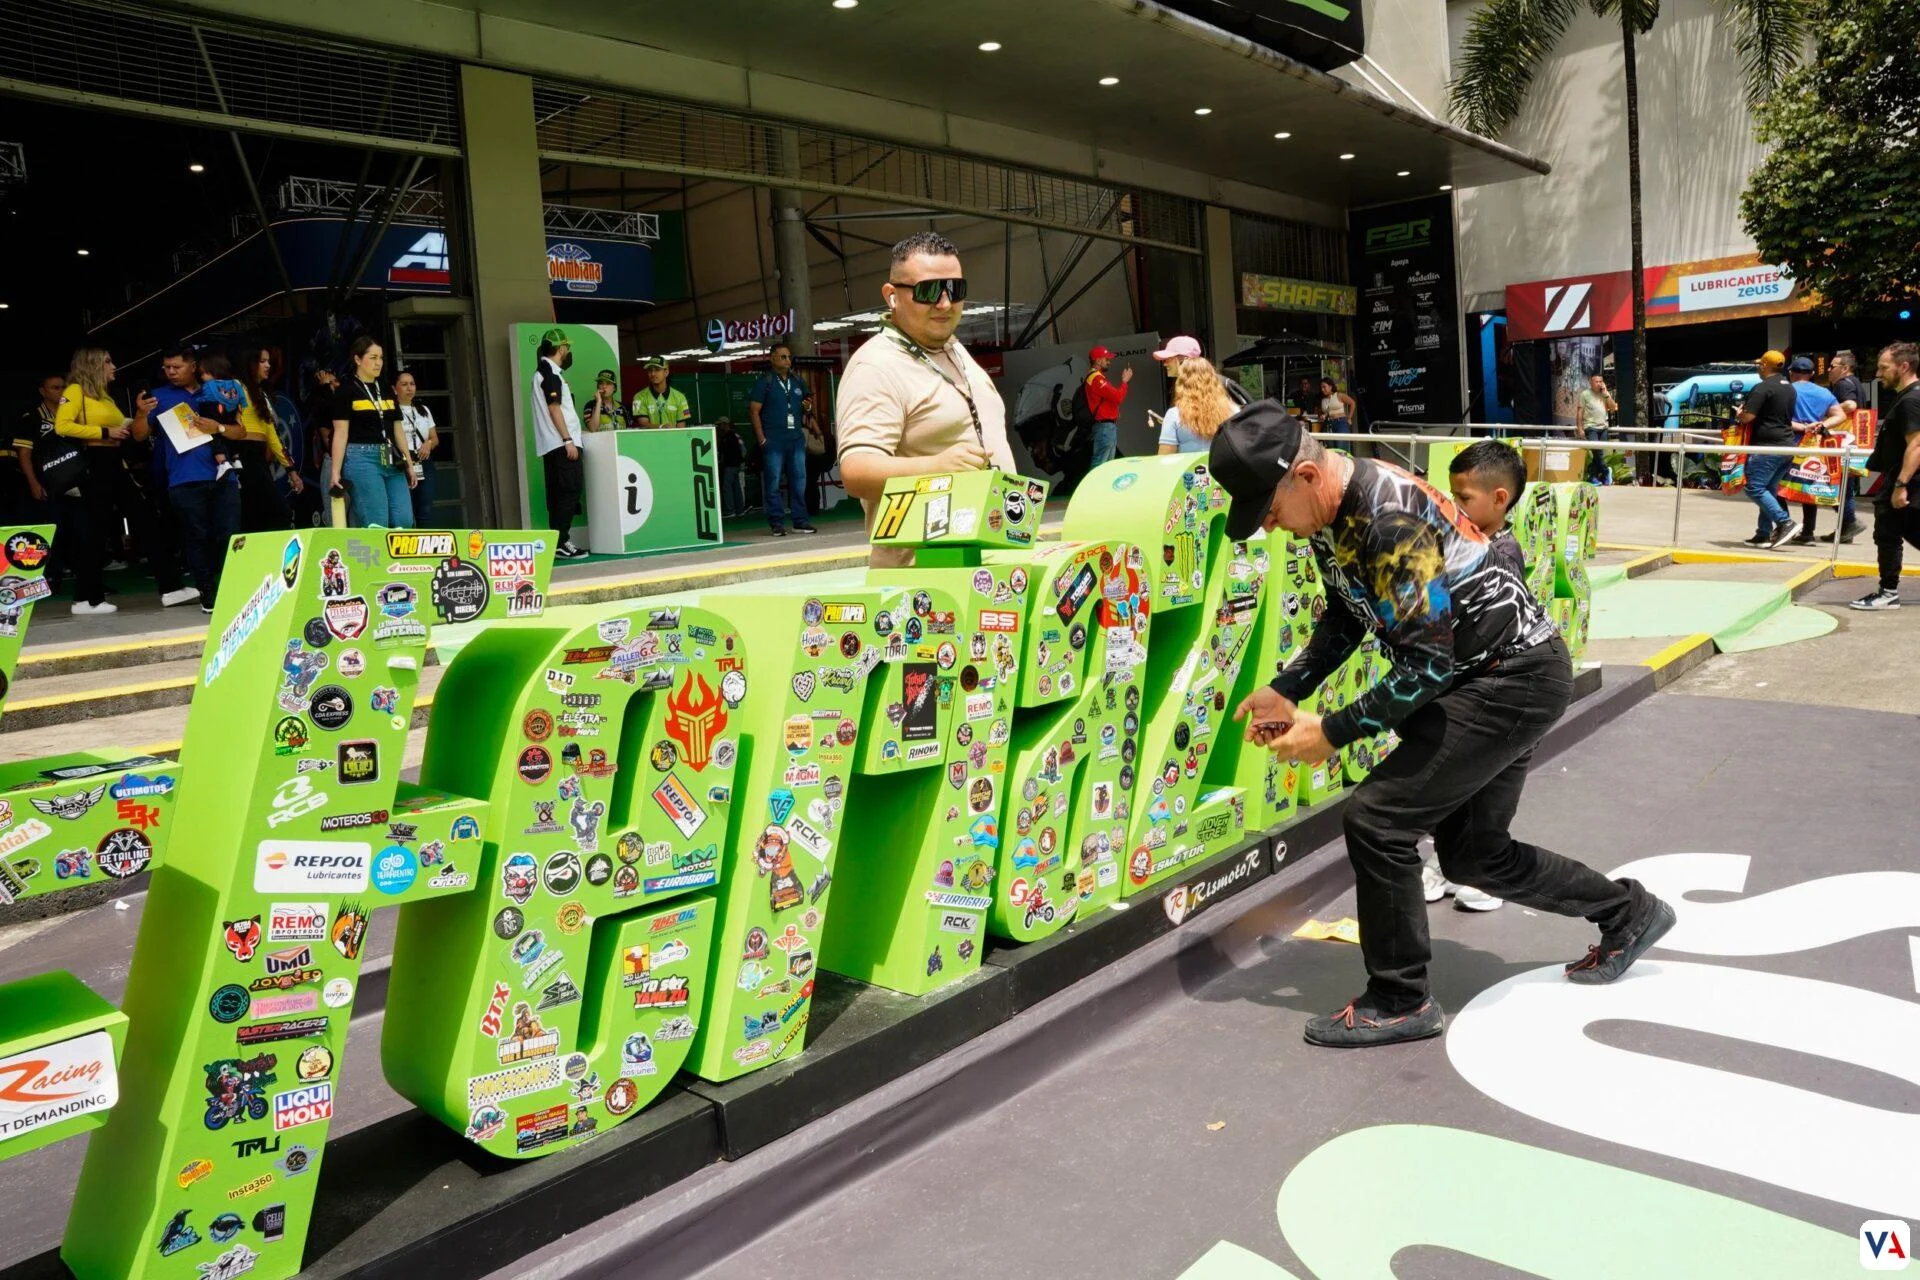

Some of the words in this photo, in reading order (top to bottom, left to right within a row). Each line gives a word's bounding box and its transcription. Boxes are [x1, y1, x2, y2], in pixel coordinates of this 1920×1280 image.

[1366, 217, 1432, 247] F2R
[1690, 271, 1781, 293] LUBRICANTES
[1262, 281, 1342, 309] SHAFT
[1737, 283, 1779, 299] zeuss
[725, 308, 795, 343] Castrol
[1398, 403, 1425, 412] Prisma
[42, 451, 78, 471] DUNLOP
[691, 437, 718, 541] F2R
[873, 490, 918, 541] H
[391, 535, 455, 556] PROTAPER
[490, 544, 533, 560] LIQUI
[490, 560, 534, 576] MOLY
[432, 580, 439, 590] 3
[433, 594, 440, 603] 2
[507, 594, 543, 610] TORO
[454, 605, 477, 614] BIKERS
[980, 612, 1017, 626] BS
[802, 631, 826, 646] House
[612, 650, 641, 665] TALLER
[884, 643, 908, 658] TORO
[967, 700, 992, 713] REMO
[562, 713, 600, 724] ELECTRA
[818, 754, 842, 762] Insta360
[908, 745, 939, 760] RINOVA
[785, 769, 820, 783] MAGNA
[116, 783, 167, 798] ULTIMOTOS
[661, 783, 697, 828] REPSOL
[791, 817, 822, 846] RCK
[100, 849, 149, 864] DETAILING
[294, 855, 364, 868] REPSOL
[647, 852, 671, 866] grua
[680, 861, 712, 874] MOTOS
[307, 871, 362, 880] Lubricantes
[429, 876, 468, 888] orbit
[655, 872, 714, 889] EUROGRIP
[1191, 849, 1261, 910] RismotoR
[937, 893, 992, 909] EUROGRIP
[272, 914, 326, 929] REMO
[650, 908, 697, 932] AMSOIL
[944, 915, 971, 929] RCK
[481, 983, 511, 1036] BTX
[621, 1069, 636, 1077] nos
[636, 1067, 656, 1076] unen
[277, 1086, 330, 1111] LIQUI
[13, 1094, 107, 1130] DEMANDING
[278, 1102, 331, 1128] MOLY
[228, 1174, 273, 1200] Insta360
